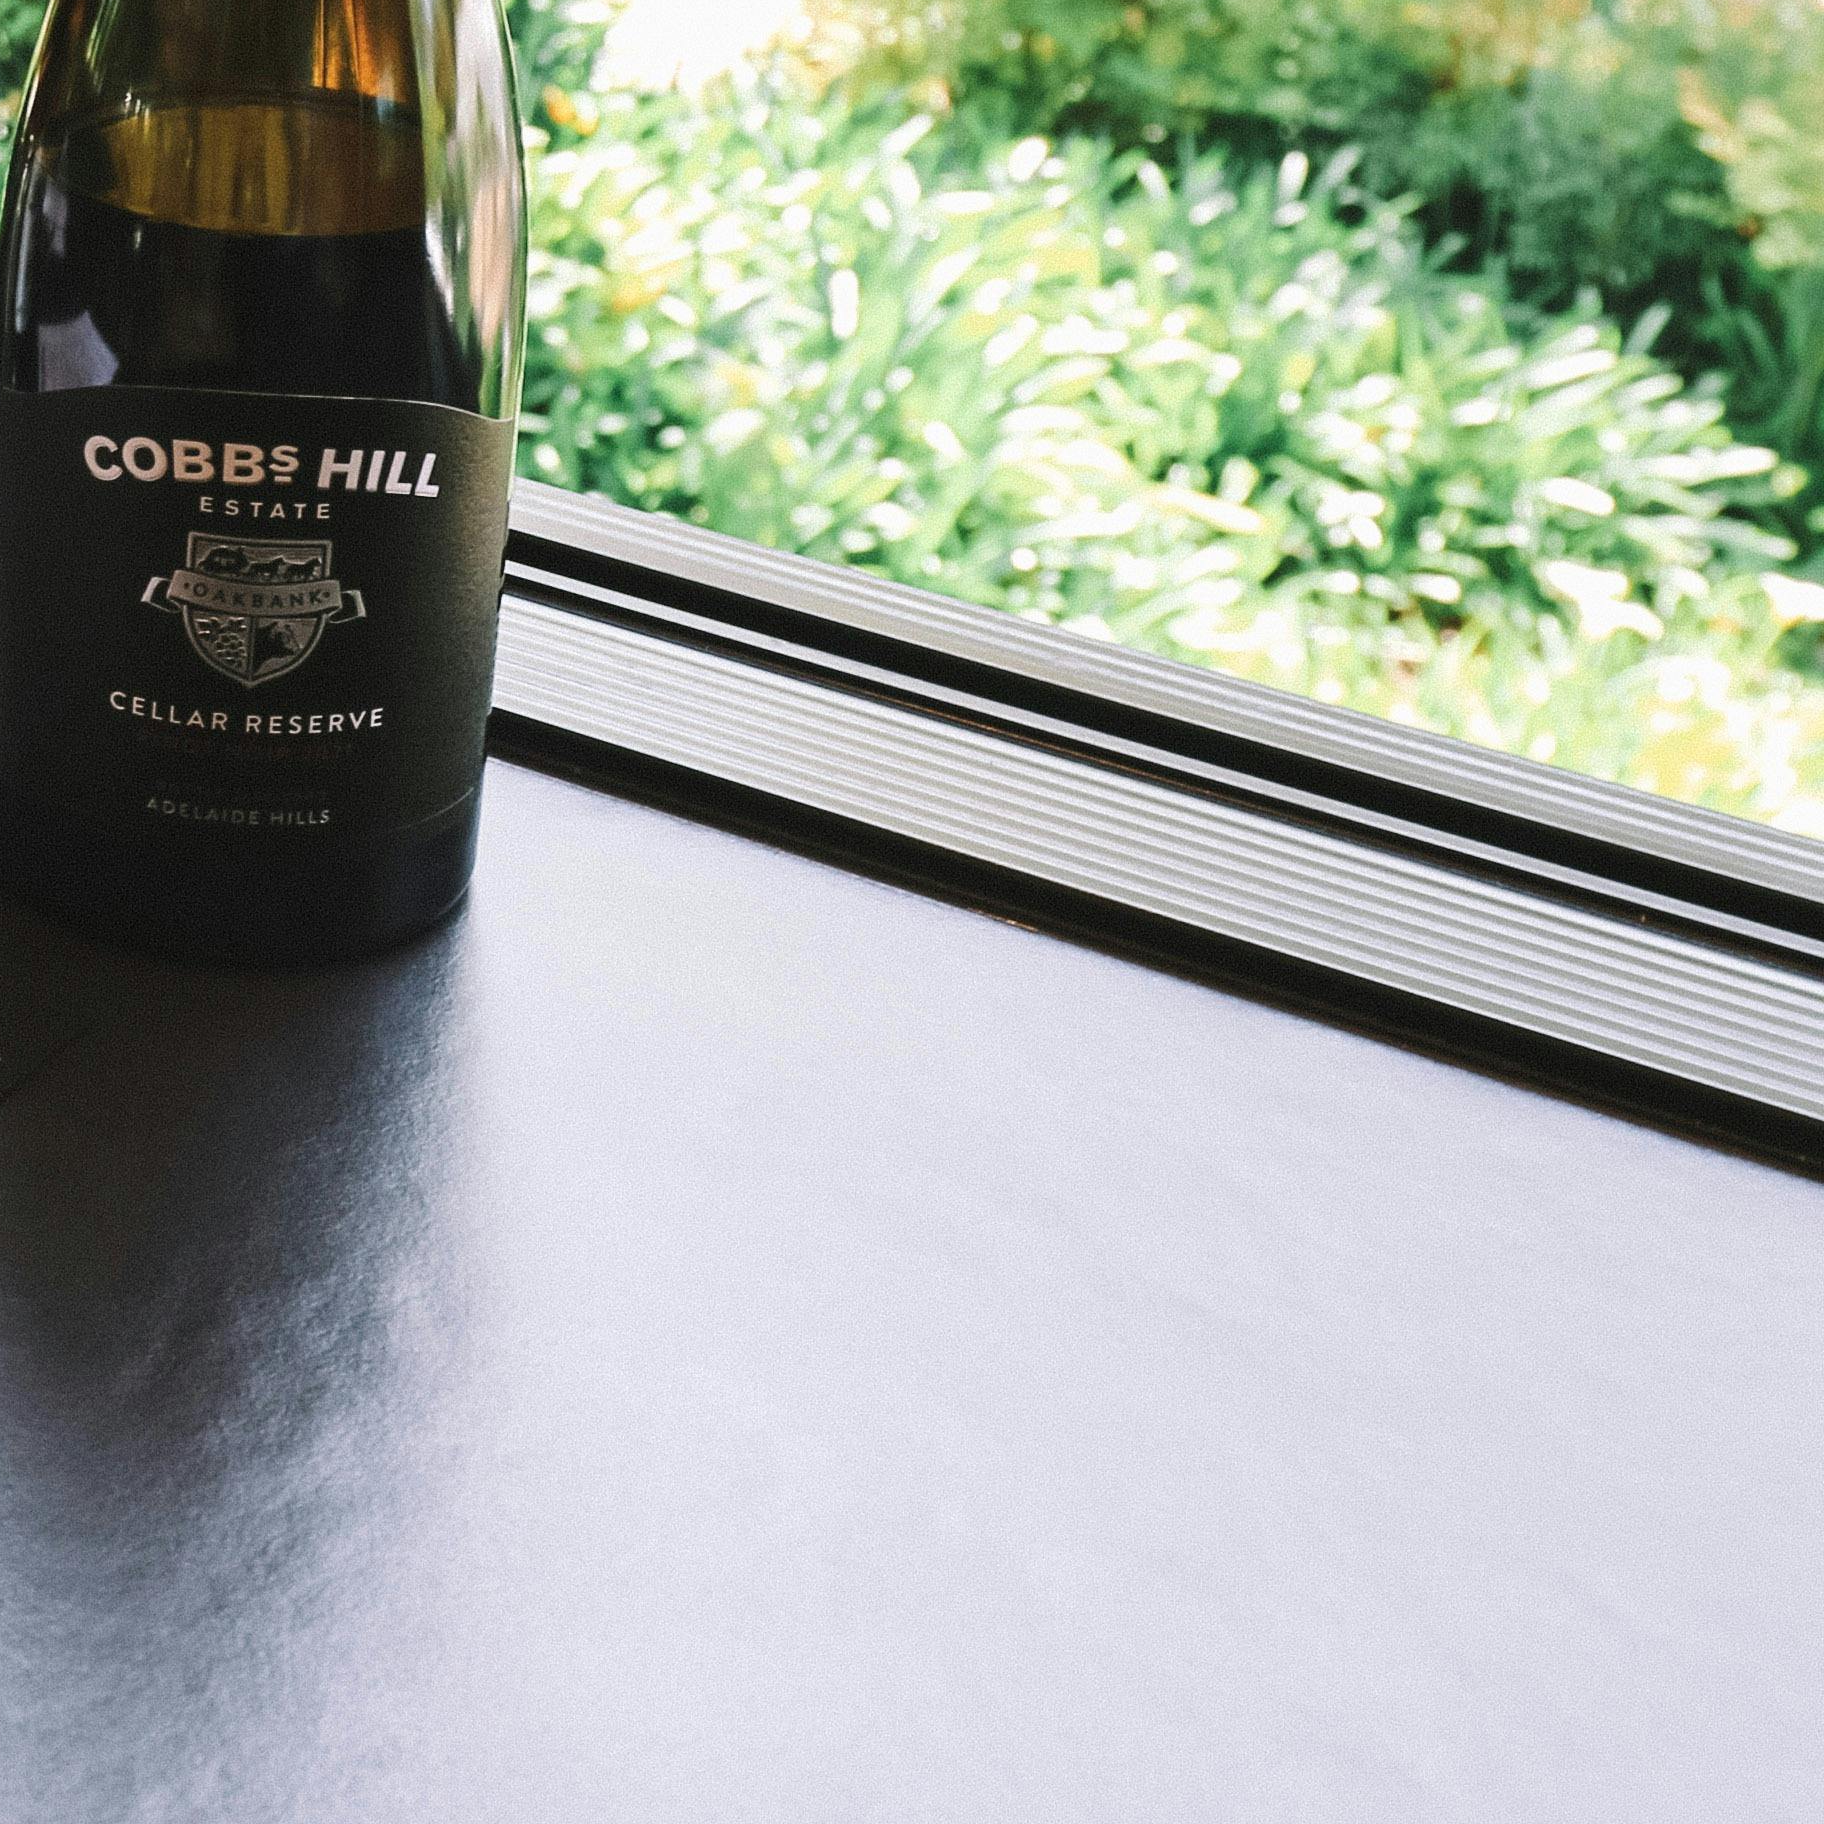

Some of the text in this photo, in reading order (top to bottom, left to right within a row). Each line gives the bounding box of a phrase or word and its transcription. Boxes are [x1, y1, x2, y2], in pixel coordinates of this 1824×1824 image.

[316, 448, 441, 498] HILL
[199, 495, 331, 520] ESTATE
[191, 580, 325, 607] OAKBANK
[109, 689, 385, 735] CELLAR RESERVE
[146, 797, 331, 826] ADELAIDE HILLS
